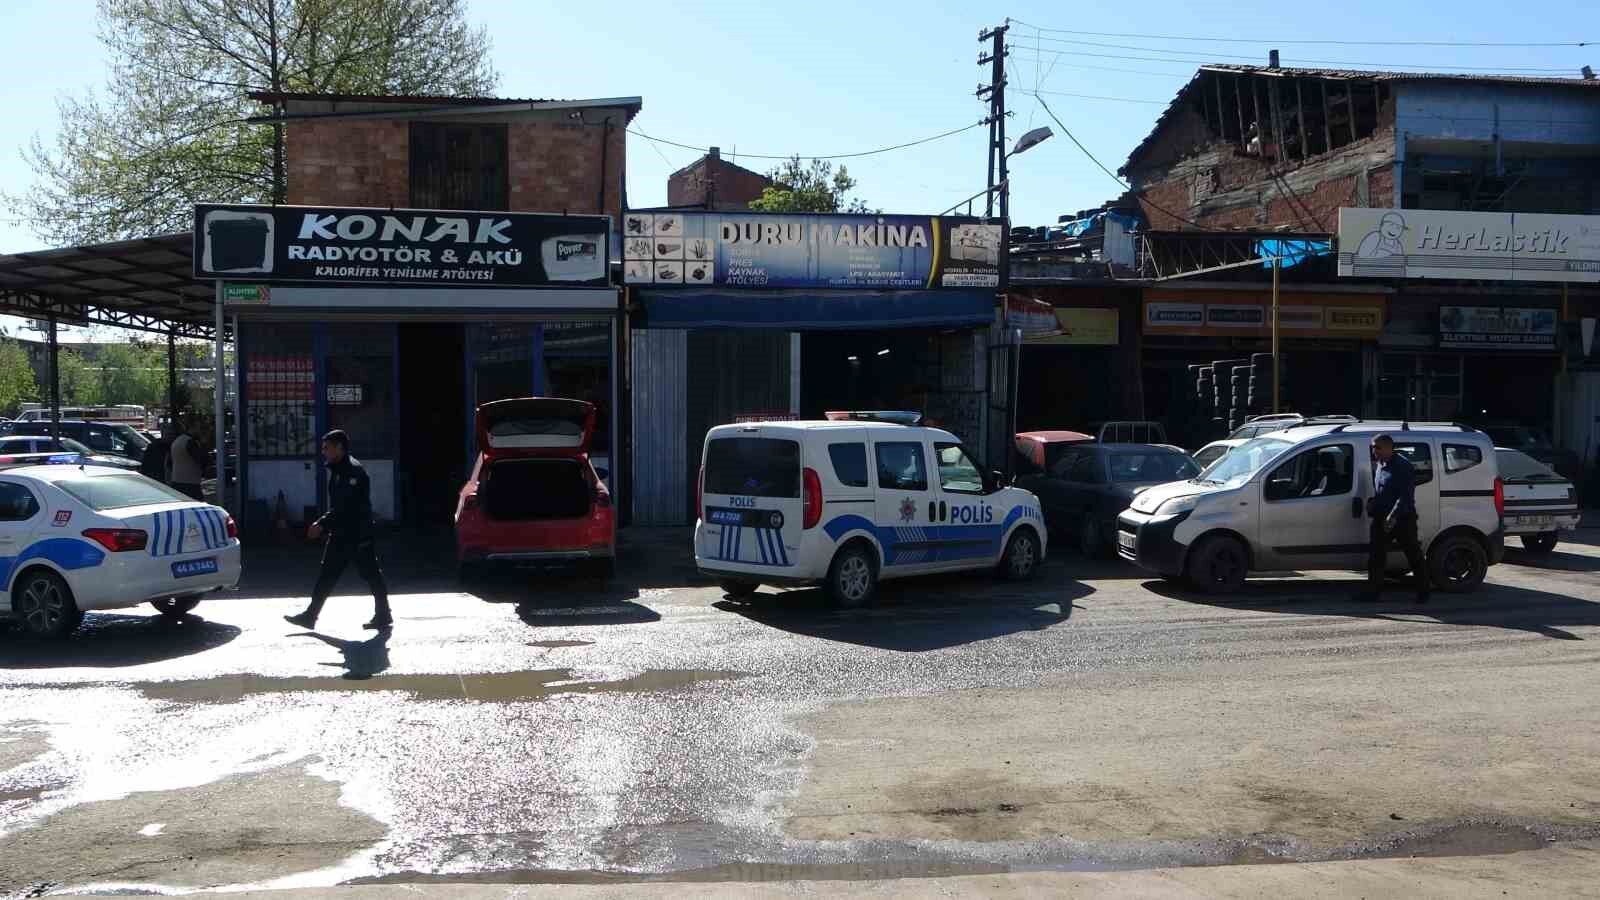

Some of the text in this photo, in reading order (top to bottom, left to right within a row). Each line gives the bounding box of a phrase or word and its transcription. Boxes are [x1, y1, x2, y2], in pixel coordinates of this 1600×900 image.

[297, 213, 512, 244] KONAK
[720, 217, 928, 248] DURU MAKİNA
[1417, 223, 1570, 255] HerLastik
[288, 245, 523, 266] RADYOTÖR & AKÜ
[315, 264, 496, 280] KALORİFER YENİLEME ATÖLYESİ
[951, 500, 993, 523] POLİS
